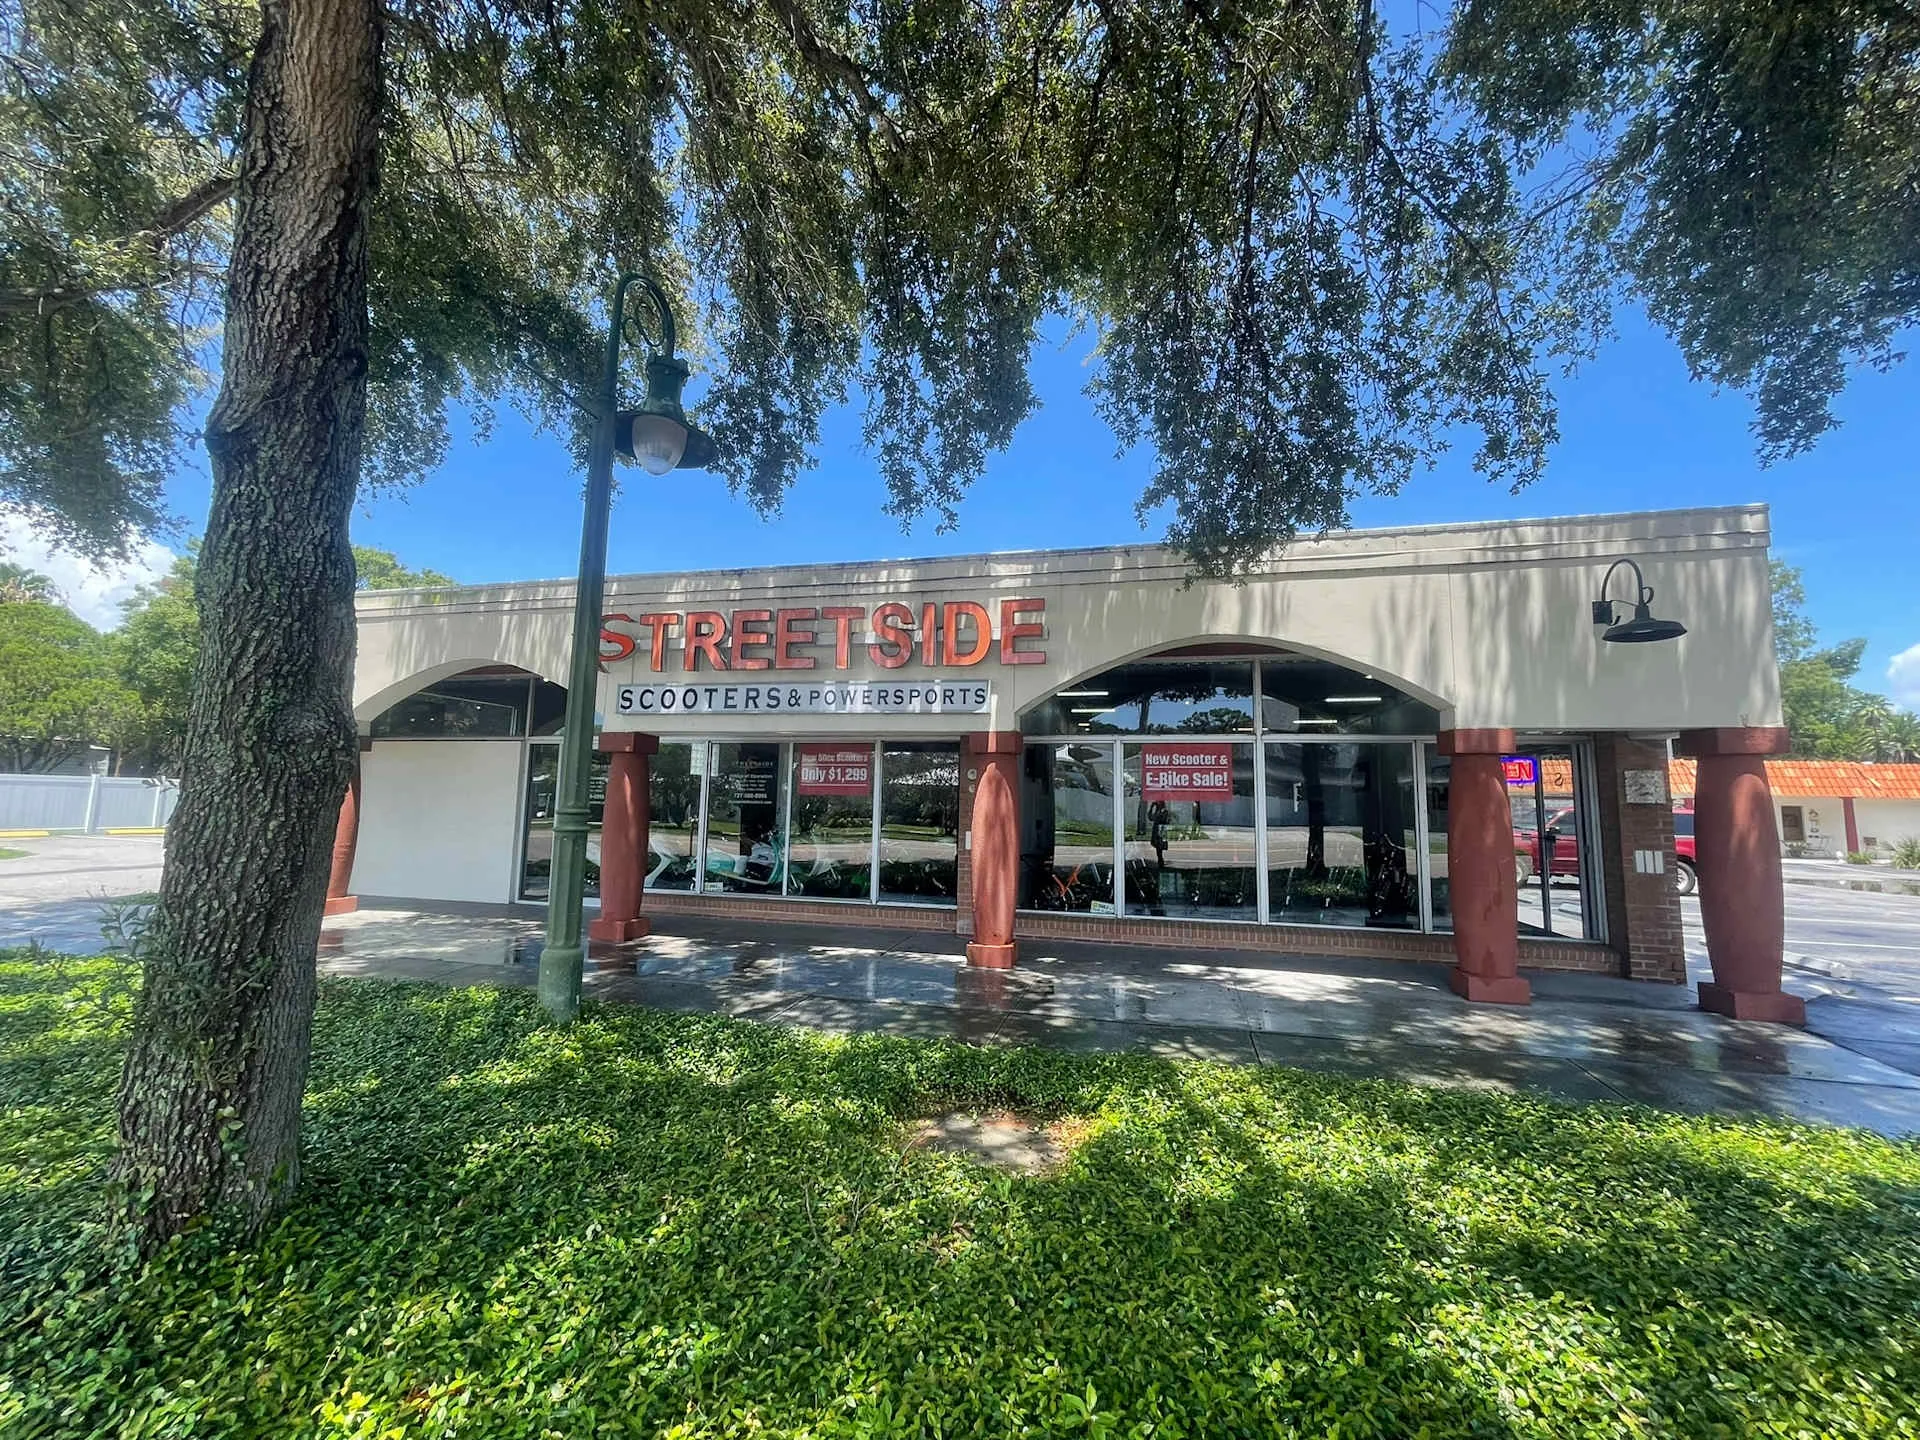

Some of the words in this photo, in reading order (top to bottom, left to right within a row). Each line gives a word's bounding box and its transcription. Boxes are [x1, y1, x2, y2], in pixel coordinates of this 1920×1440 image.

[600, 599, 1046, 673] STREETSIDE
[620, 688, 781, 710] SCOOTERS
[809, 688, 986, 706] POWERSPORTS
[1145, 753, 1170, 765] New
[1172, 753, 1217, 765] Scooter
[1219, 754, 1228, 765] &
[801, 767, 826, 783] Only
[828, 766, 868, 783] $1,299
[1145, 771, 1189, 786] E-Bike
[1192, 771, 1228, 786] Sale!
